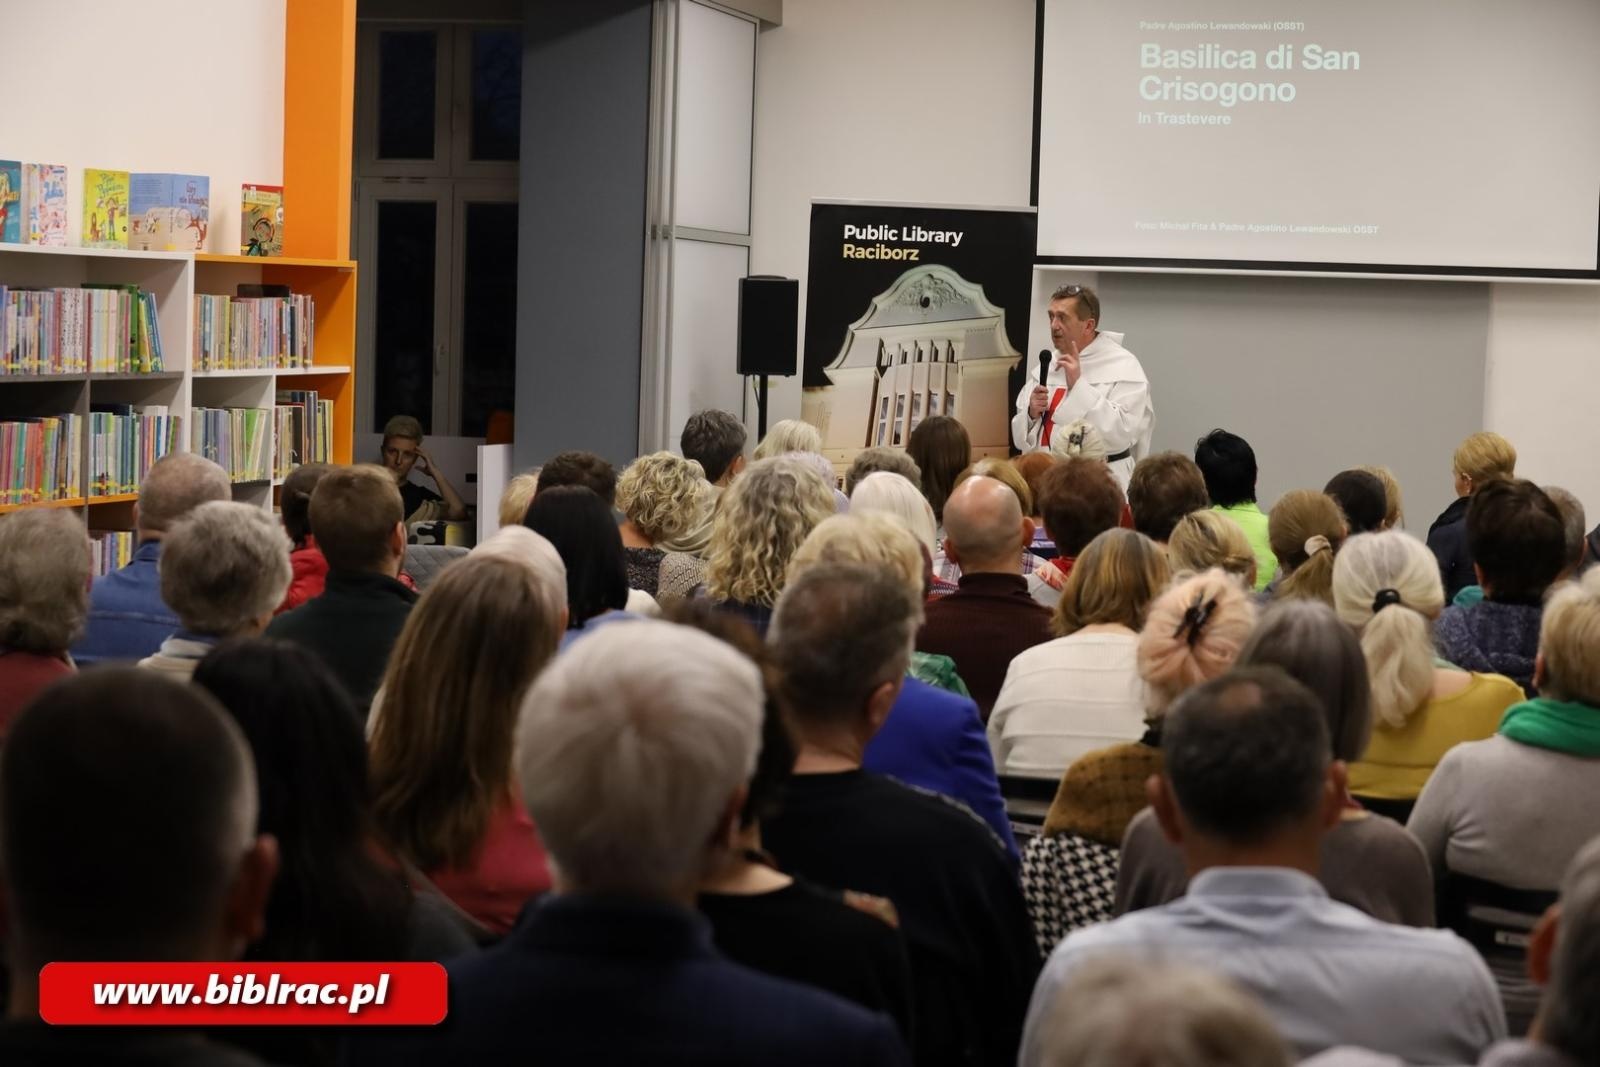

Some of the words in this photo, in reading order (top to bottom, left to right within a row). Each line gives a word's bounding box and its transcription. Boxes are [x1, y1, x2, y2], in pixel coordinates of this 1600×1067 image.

[1210, 21, 1271, 31] Lewandowski
[1273, 21, 1305, 32] (OSST)
[1139, 43, 1257, 71] Basilica
[1266, 43, 1293, 71] di
[1301, 44, 1360, 71] San
[1138, 75, 1296, 107] Crisogono
[1137, 111, 1151, 125] In
[1156, 111, 1231, 126] Trastevere
[843, 224, 898, 241] Public
[902, 226, 963, 247] Library
[1290, 223, 1351, 234] Lewandowski
[1353, 224, 1379, 234] OSST
[843, 243, 919, 261] Raciborz
